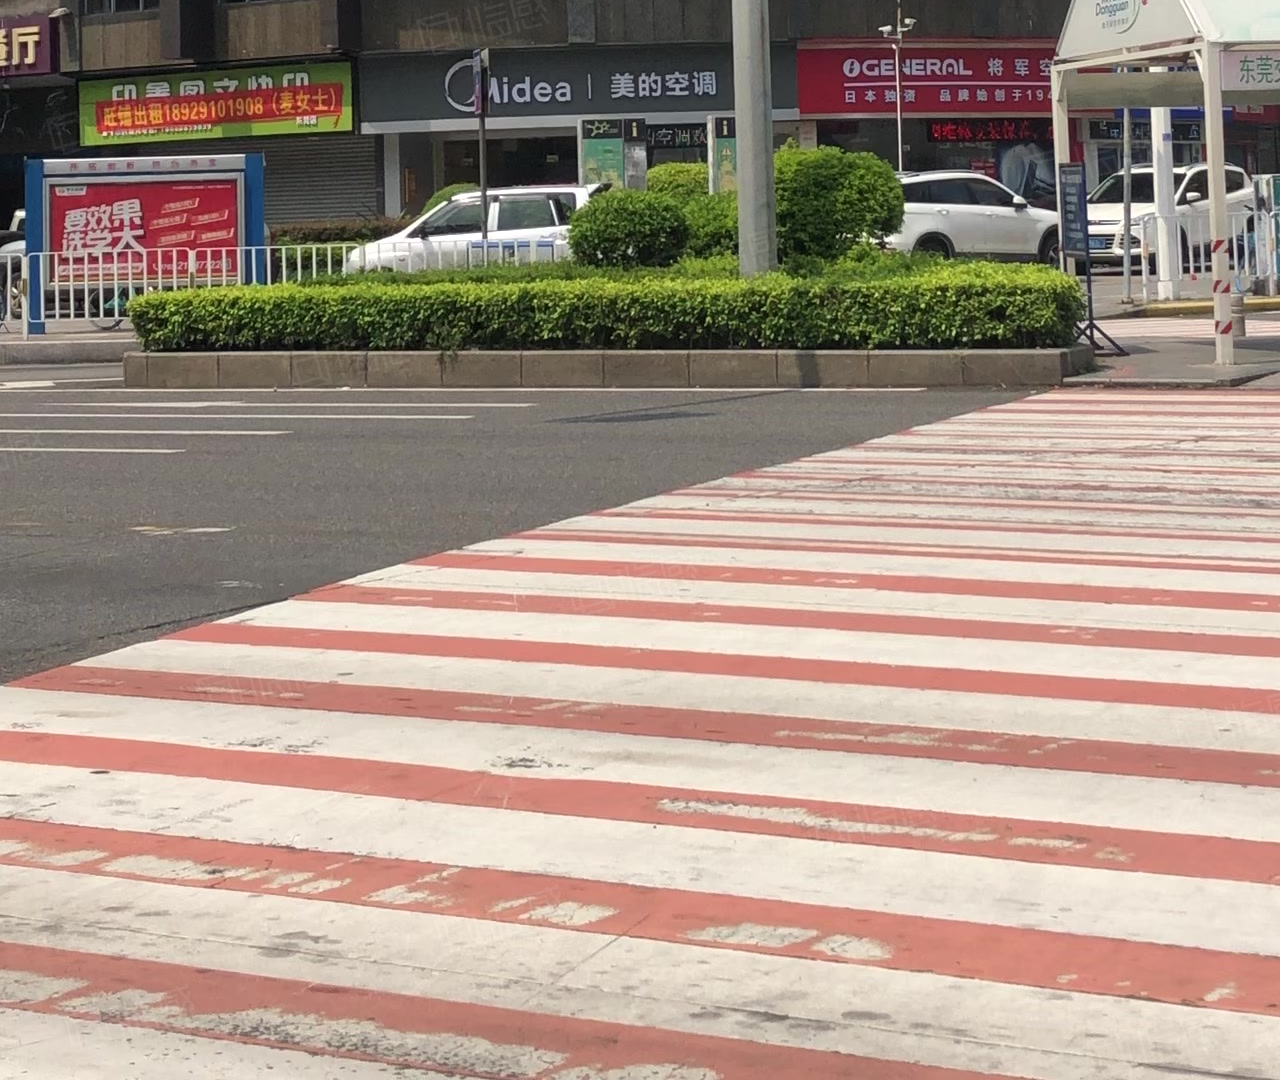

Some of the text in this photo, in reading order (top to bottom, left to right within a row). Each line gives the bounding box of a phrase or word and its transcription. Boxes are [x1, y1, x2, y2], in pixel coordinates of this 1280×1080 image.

[611, 71, 717, 98] 美的空调
[64, 198, 143, 234] 要效果
